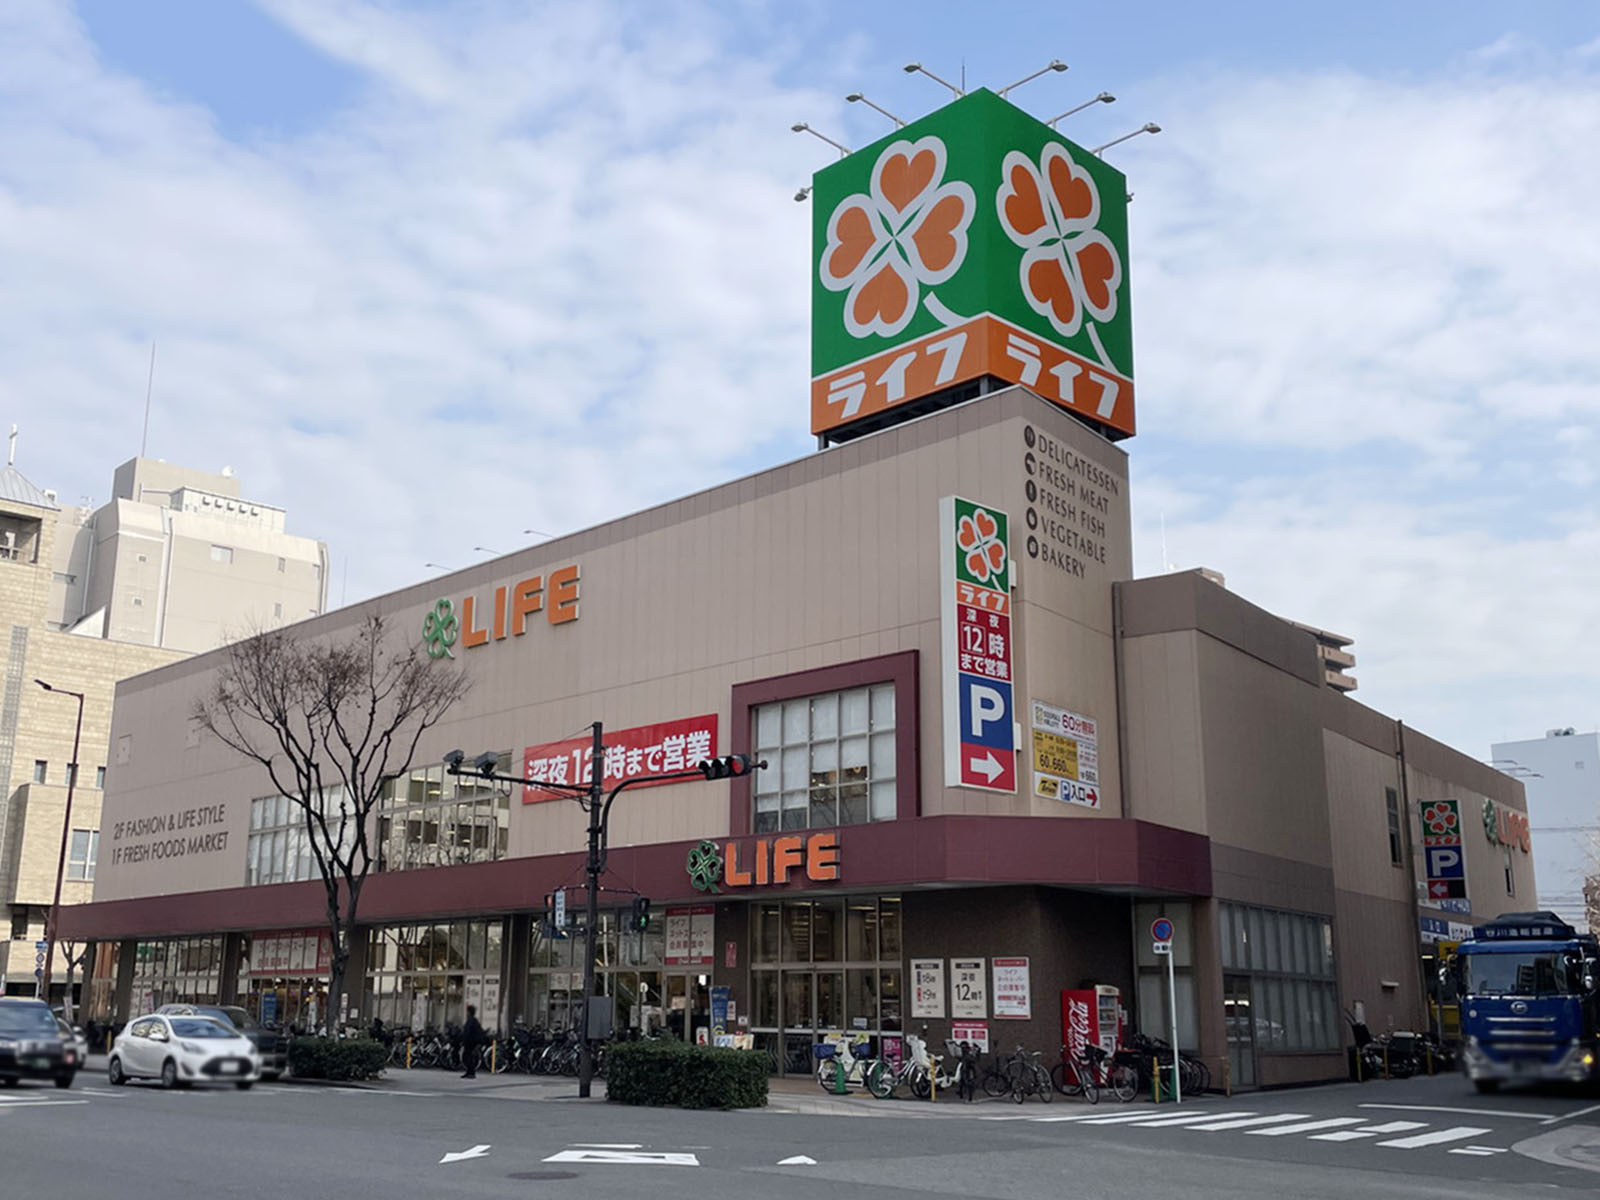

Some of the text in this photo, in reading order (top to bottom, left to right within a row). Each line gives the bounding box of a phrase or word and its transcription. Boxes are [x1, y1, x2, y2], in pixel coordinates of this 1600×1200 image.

[827, 332, 968, 419] ライフ
[1007, 333, 1120, 420] ライフ
[1038, 433, 1120, 498] DELICATESSEN
[1038, 461, 1110, 516] FRESH MEAT
[1039, 488, 1107, 540] FRESH FISH
[1040, 515, 1107, 566] VEGETABLE
[1041, 545, 1087, 581] BAKERY
[461, 564, 581, 648] LIFE
[960, 584, 1005, 611] ライフ
[960, 653, 1009, 679] まで営業
[963, 625, 1005, 659] 12時
[970, 683, 1005, 737] P
[1060, 779, 1086, 802] P 入口
[114, 804, 225, 840] 2F FASHION & LIFE STYLE
[112, 831, 229, 865] 1F FRESH FOODS MARKET
[725, 833, 841, 887] LIFE
[1431, 849, 1459, 877] P
